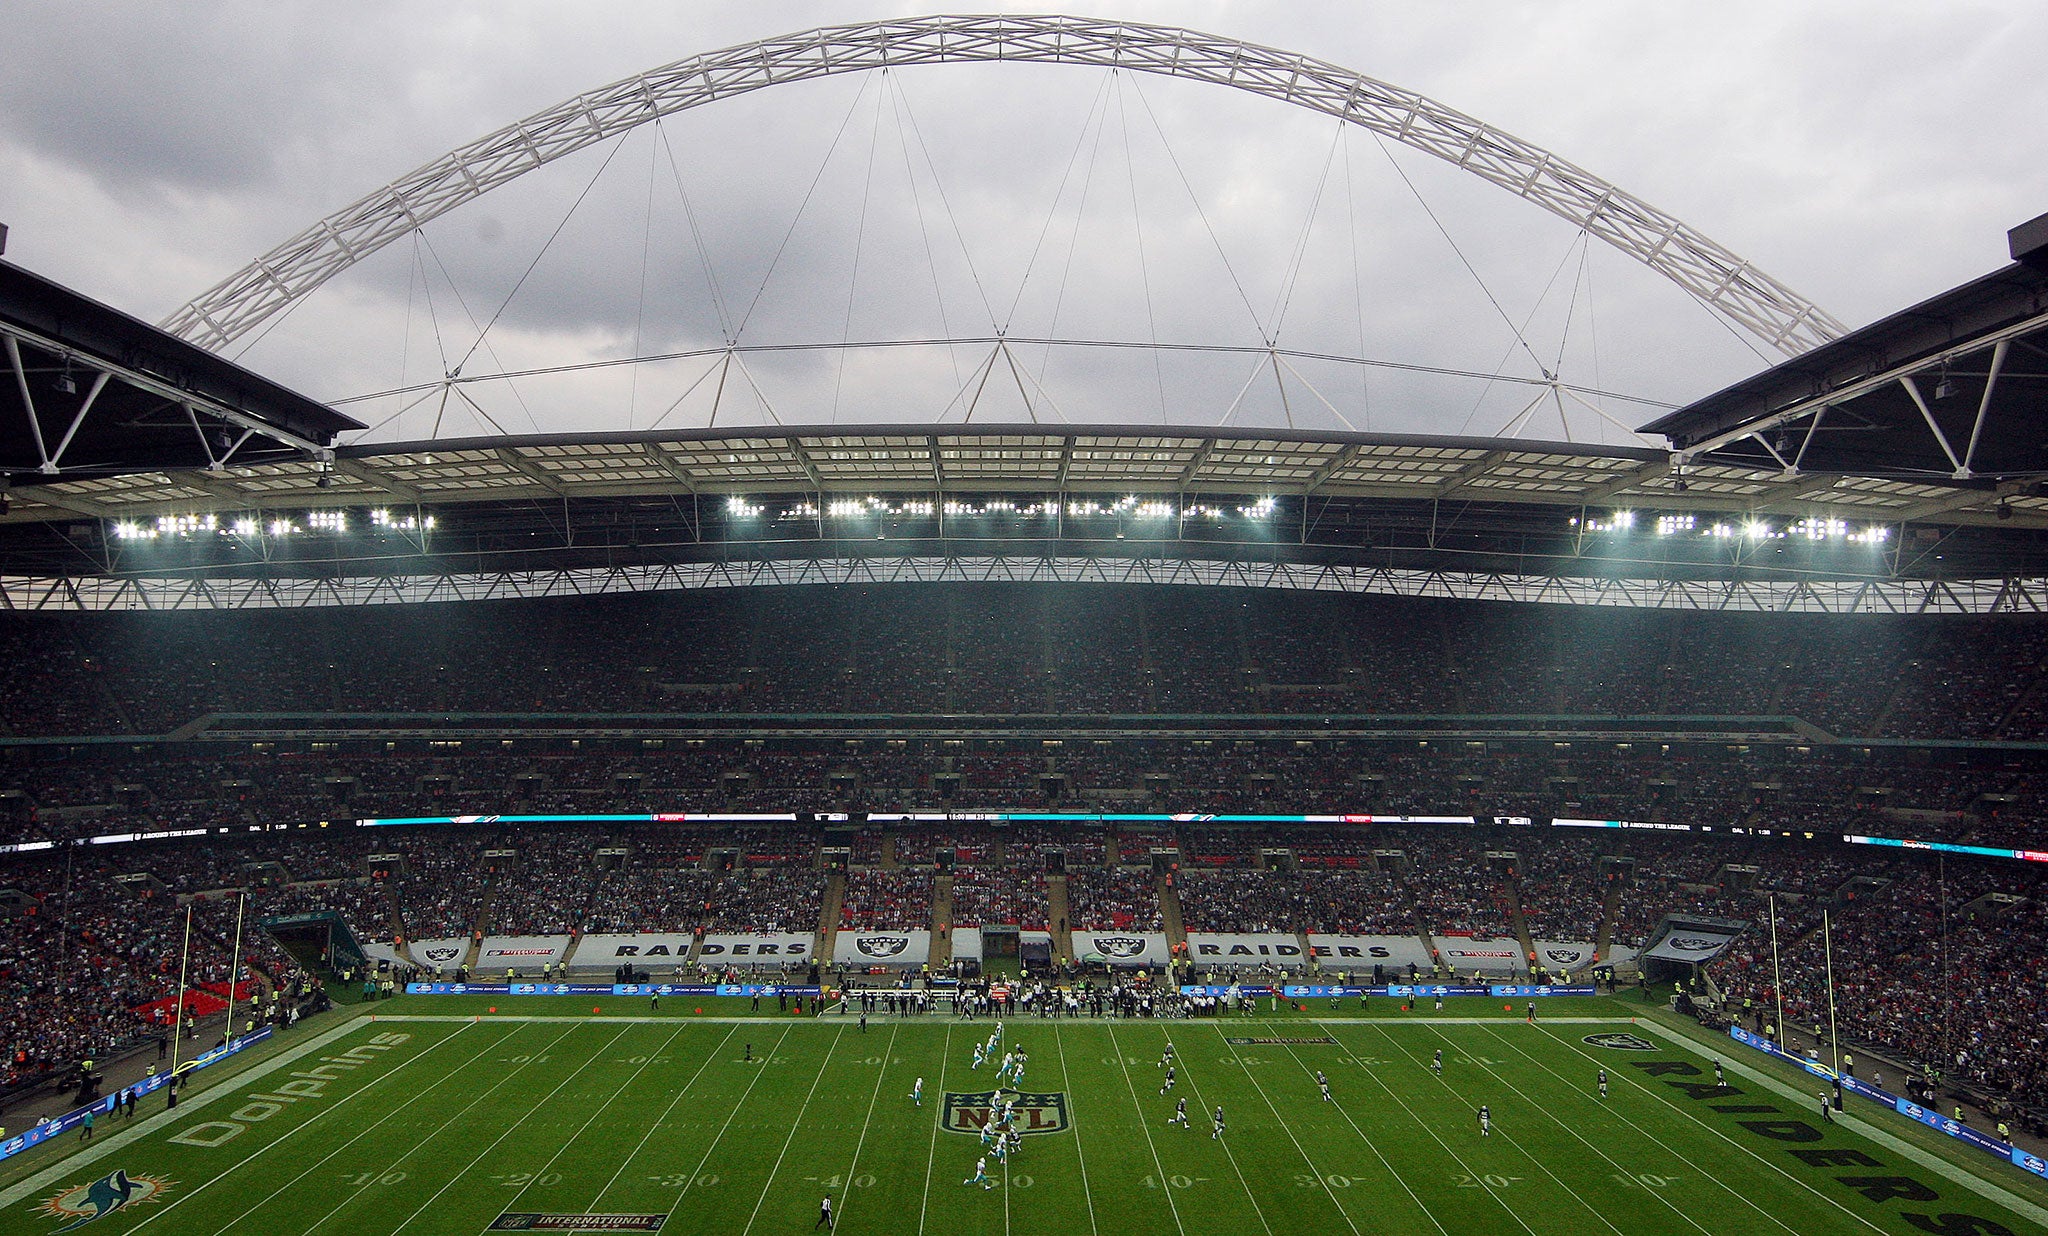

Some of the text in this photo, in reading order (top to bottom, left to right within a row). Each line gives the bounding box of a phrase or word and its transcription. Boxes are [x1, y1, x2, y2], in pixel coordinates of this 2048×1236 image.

[167, 1032, 411, 1148] Dolphins
[955, 1108, 1057, 1132] NFL
[1630, 1061, 2016, 1236] RAIDERS
[501, 1173, 563, 1186] 20
[661, 1173, 720, 1187] 30
[820, 1174, 877, 1188] 40
[1137, 1174, 1193, 1189] 40
[1450, 1174, 1509, 1188] 20
[537, 1215, 649, 1224] INTERNATIONAL
